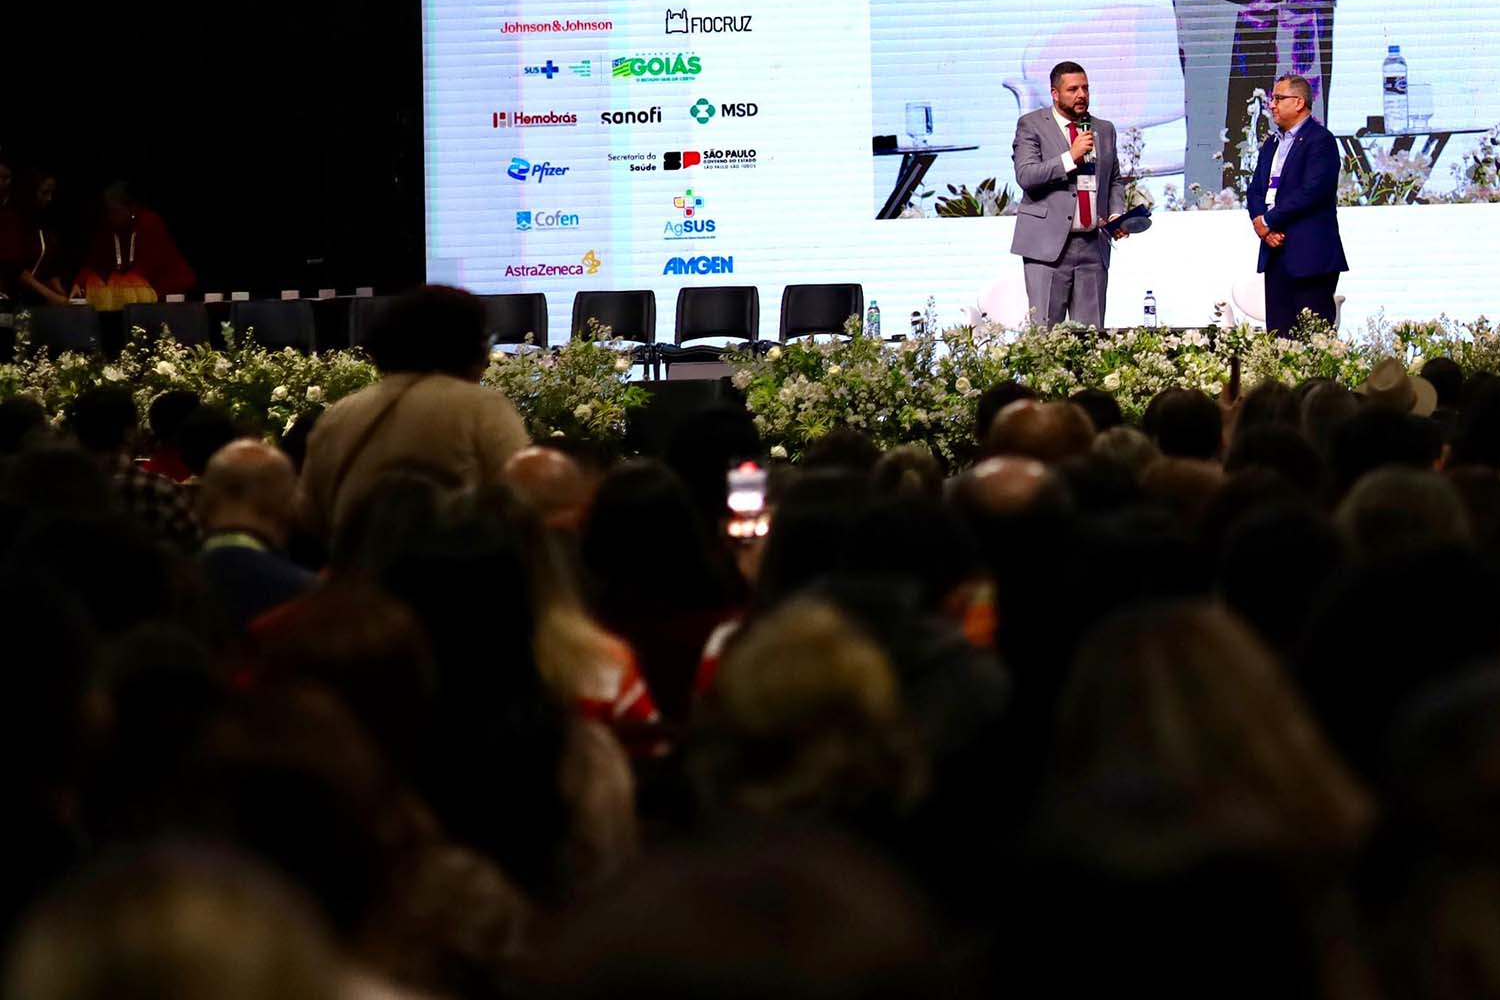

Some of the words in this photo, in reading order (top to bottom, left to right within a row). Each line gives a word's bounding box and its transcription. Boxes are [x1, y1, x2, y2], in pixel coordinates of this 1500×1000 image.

[501, 19, 613, 34] Johnson&Johnson
[692, 15, 752, 33] FIOCRUZ
[524, 66, 540, 74] SUS
[630, 52, 702, 76] GOIÁS
[600, 107, 662, 125] sanofi
[721, 103, 758, 117] MSD
[514, 111, 577, 125] Hemobrás
[608, 153, 645, 161] Secretaria
[647, 152, 656, 160] da
[703, 148, 723, 159] SÃO
[725, 149, 757, 158] PAULO
[531, 162, 570, 183] Pfizer
[630, 163, 656, 172] Saúde
[534, 211, 579, 227] Cofen
[664, 219, 716, 236] AgSUS
[505, 262, 583, 277] AstraZeneca
[663, 255, 734, 275] AMGEN
